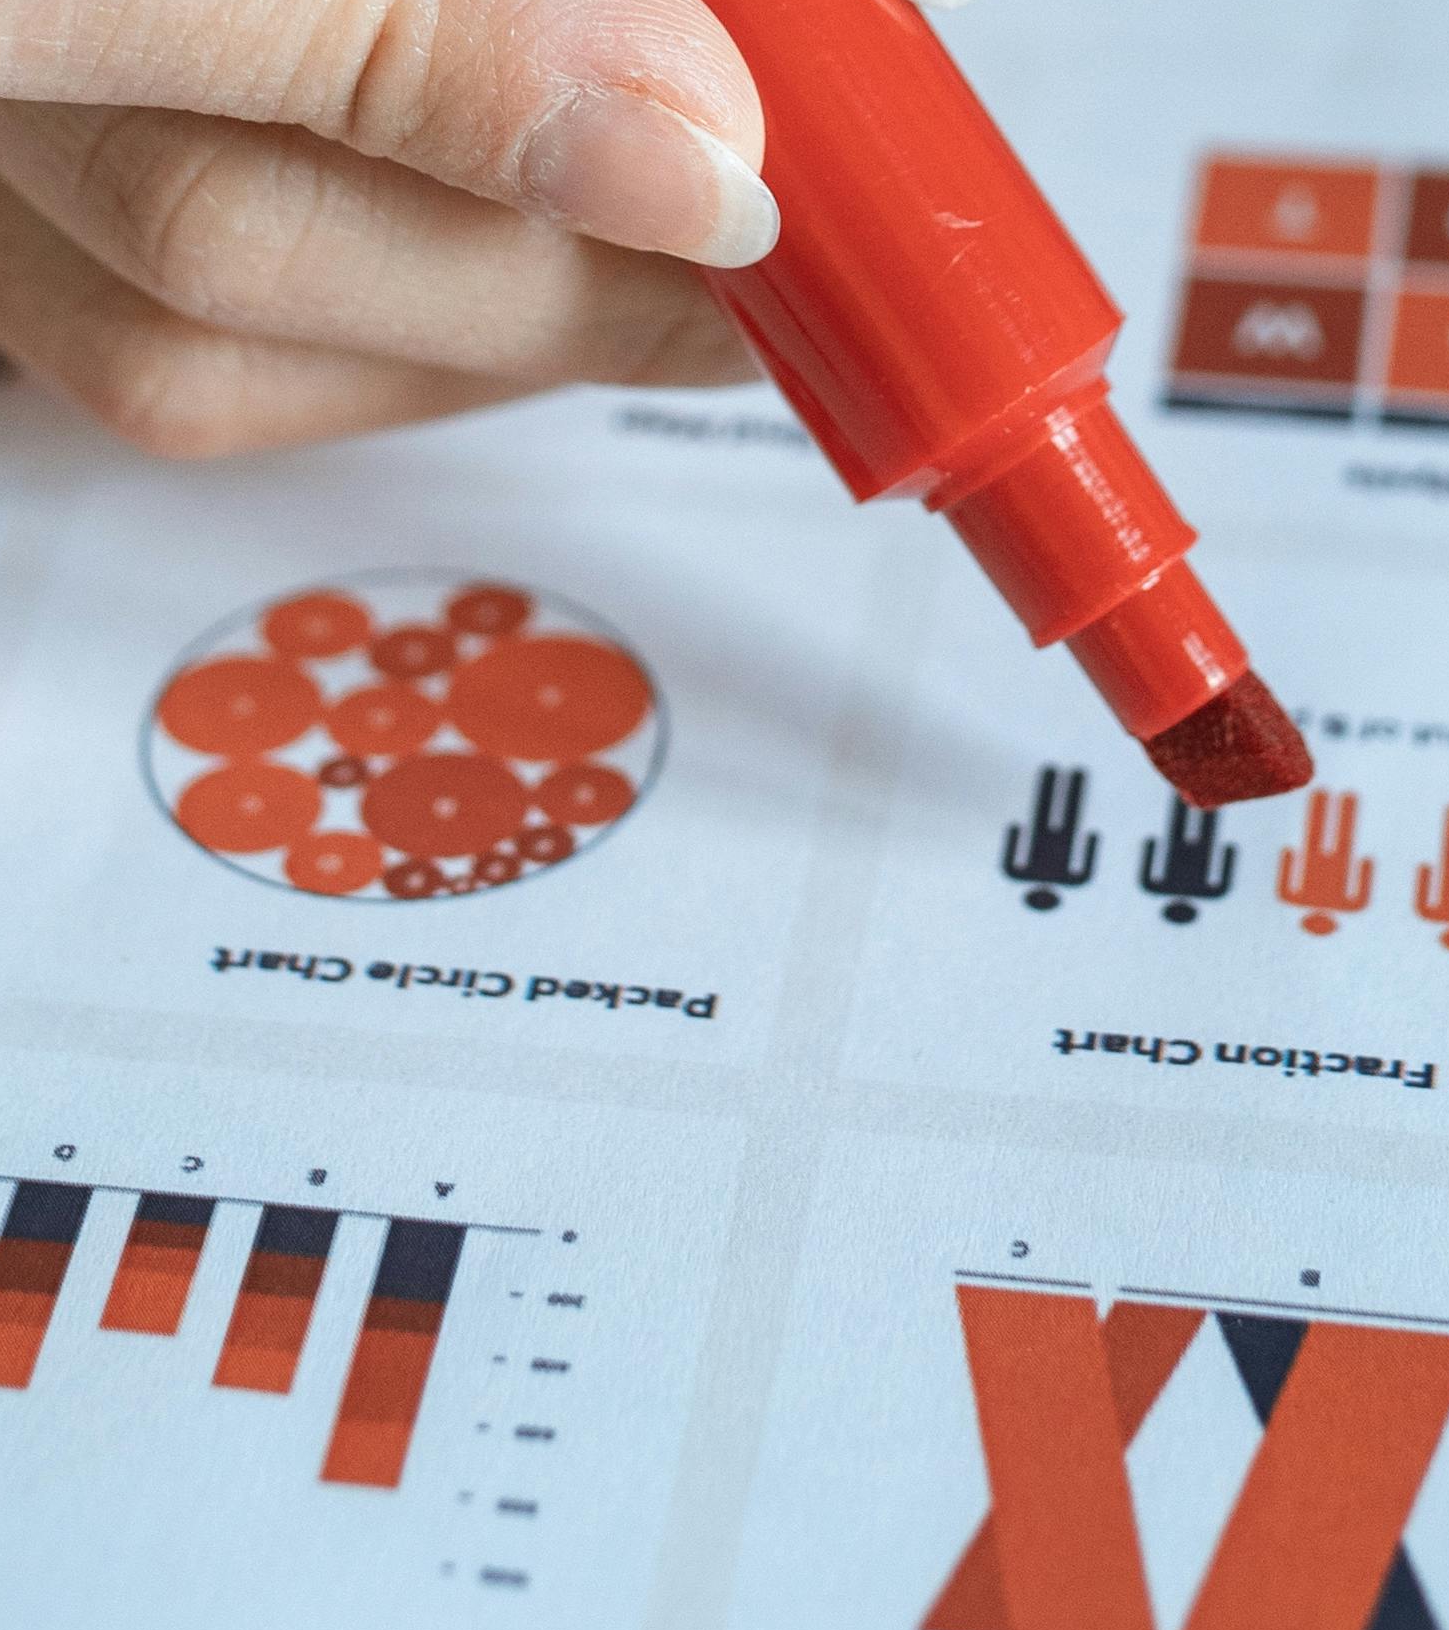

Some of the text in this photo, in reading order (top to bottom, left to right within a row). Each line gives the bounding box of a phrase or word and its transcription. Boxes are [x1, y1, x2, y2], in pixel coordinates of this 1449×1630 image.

[212, 948, 717, 1019] Packed Circle Chart
[1054, 1030, 1202, 1065] Chart
[1215, 1043, 1435, 1089] Fraction
[182, 1156, 204, 1173] C
[1012, 1241, 1030, 1259] C
